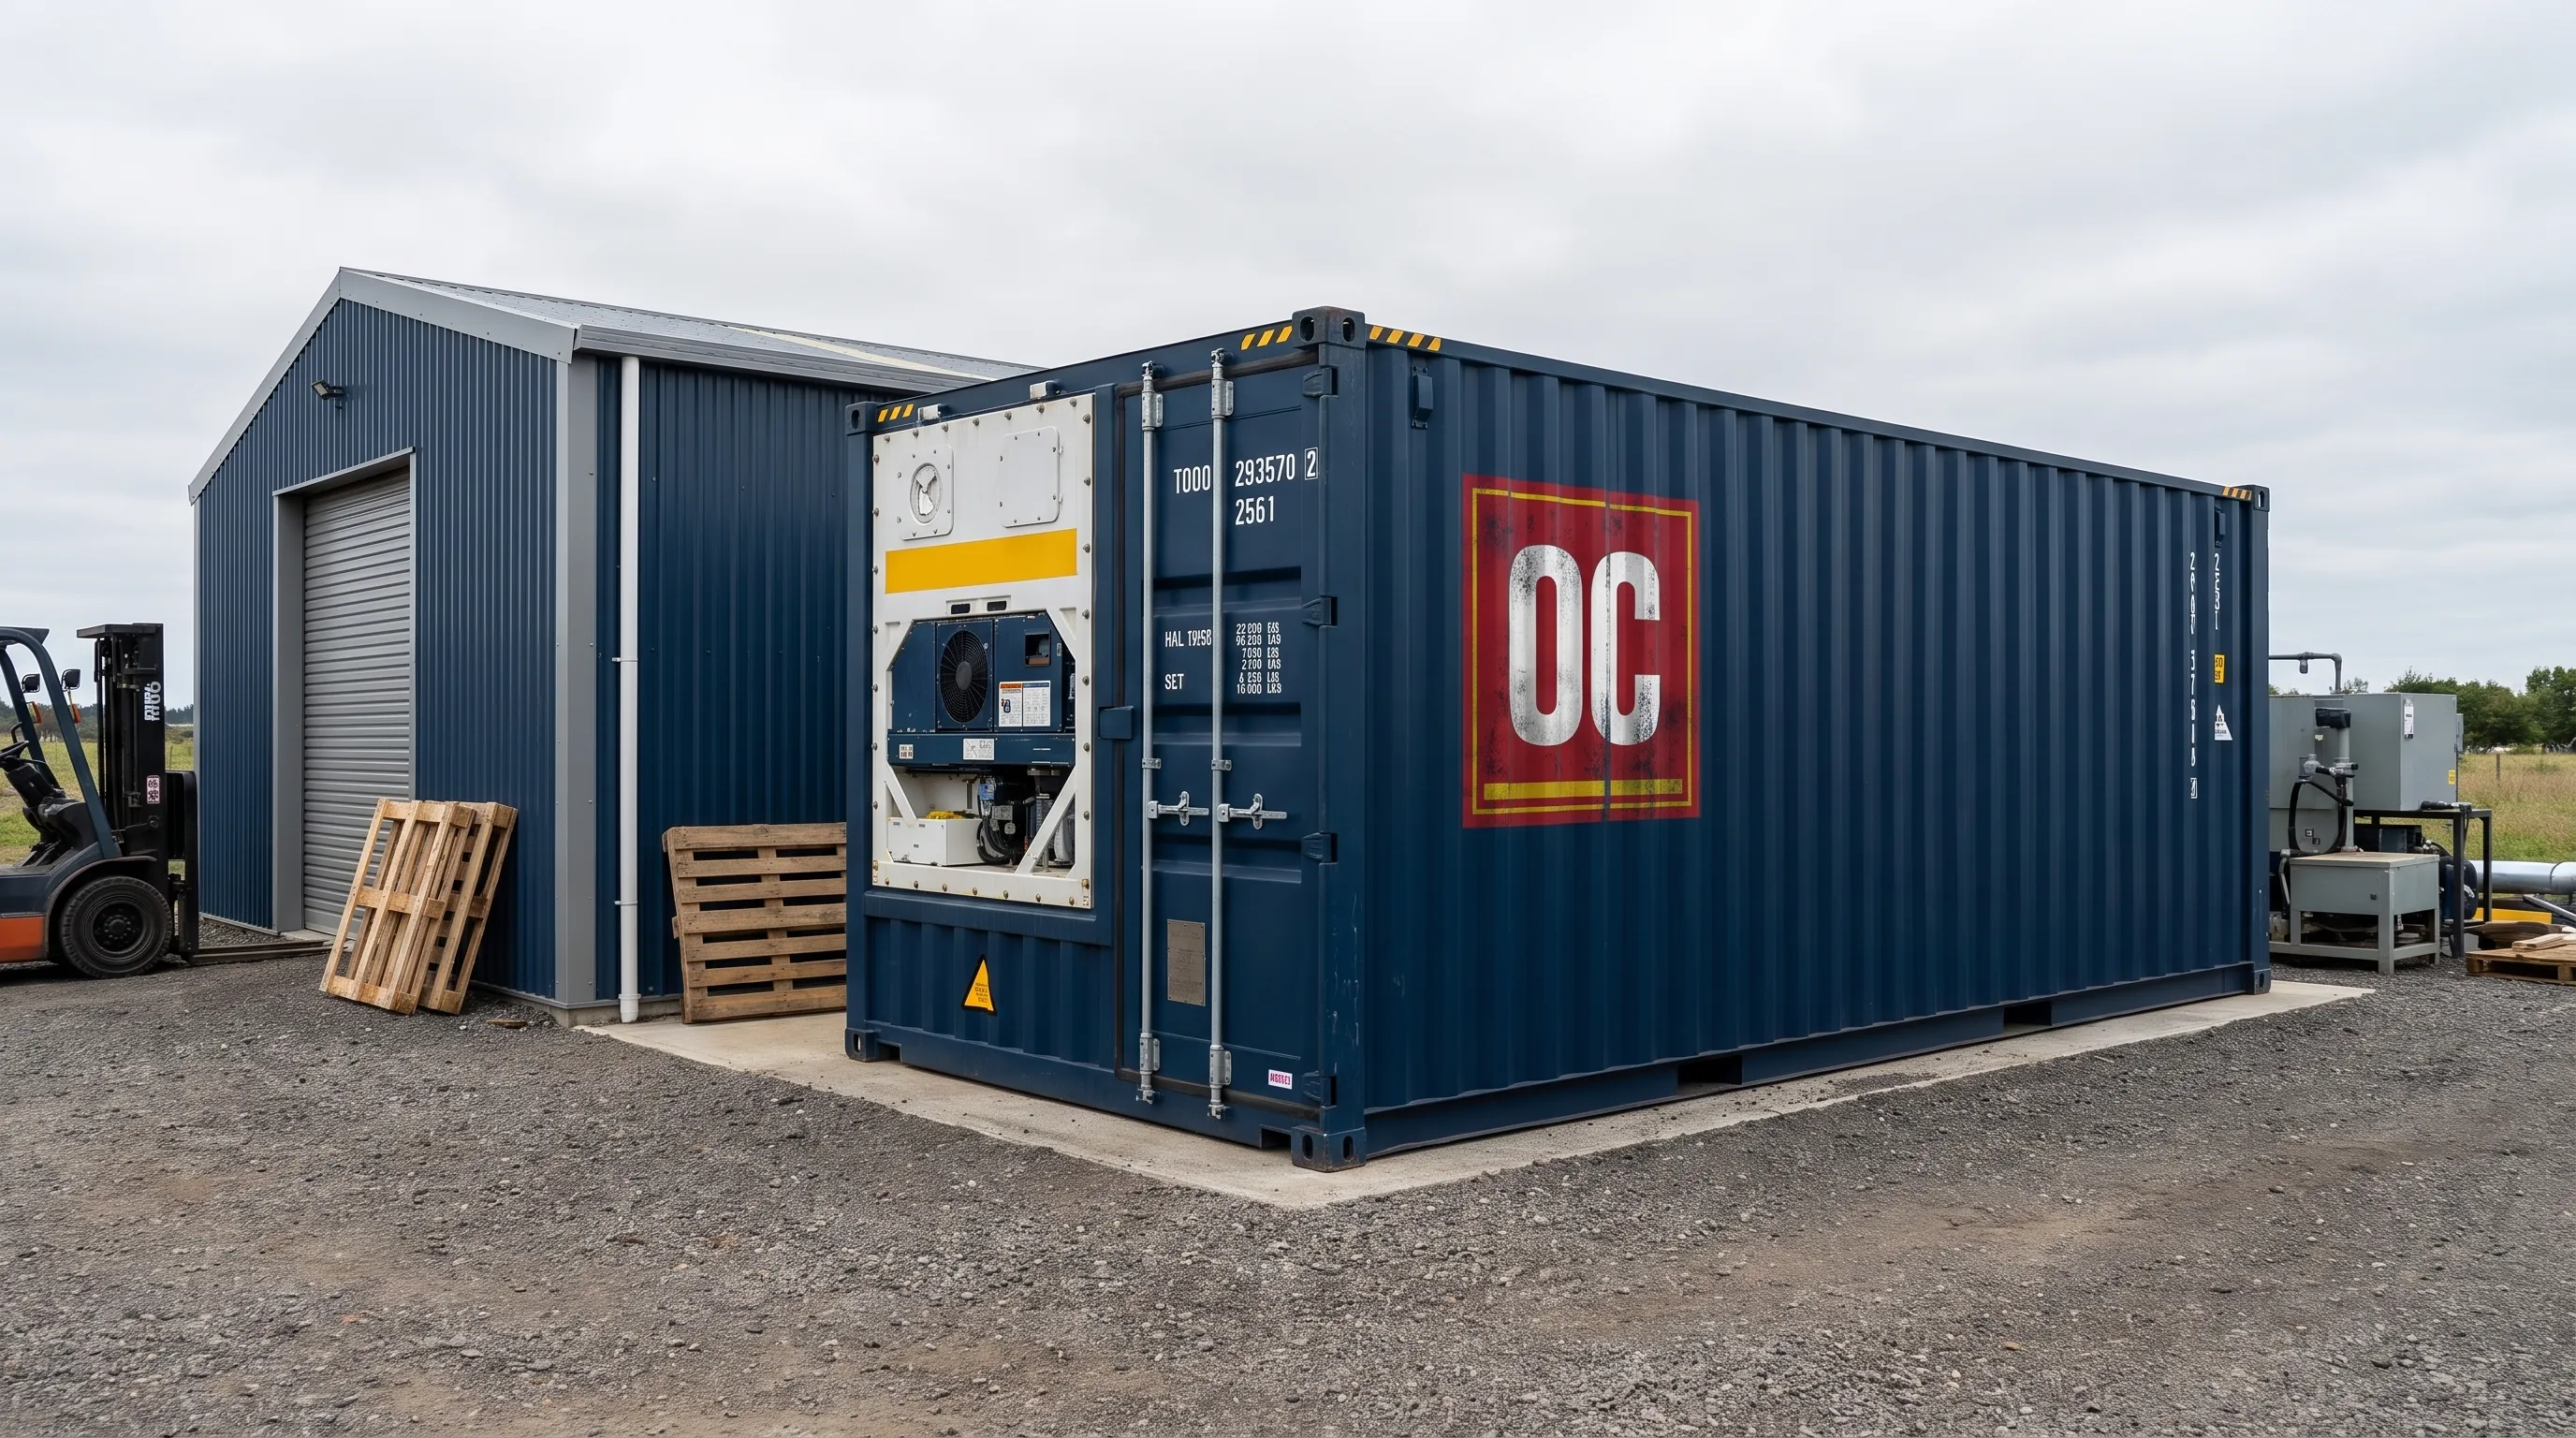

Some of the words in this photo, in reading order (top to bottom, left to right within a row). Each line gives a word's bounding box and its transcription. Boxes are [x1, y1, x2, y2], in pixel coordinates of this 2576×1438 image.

[1235, 453, 1295, 487] 293570
[1306, 449, 1316, 478] 2
[1235, 495, 1274, 526] 2561
[1164, 630, 1184, 648] HAL
[1508, 544, 1661, 746] OC
[1164, 673, 1184, 690] SET
